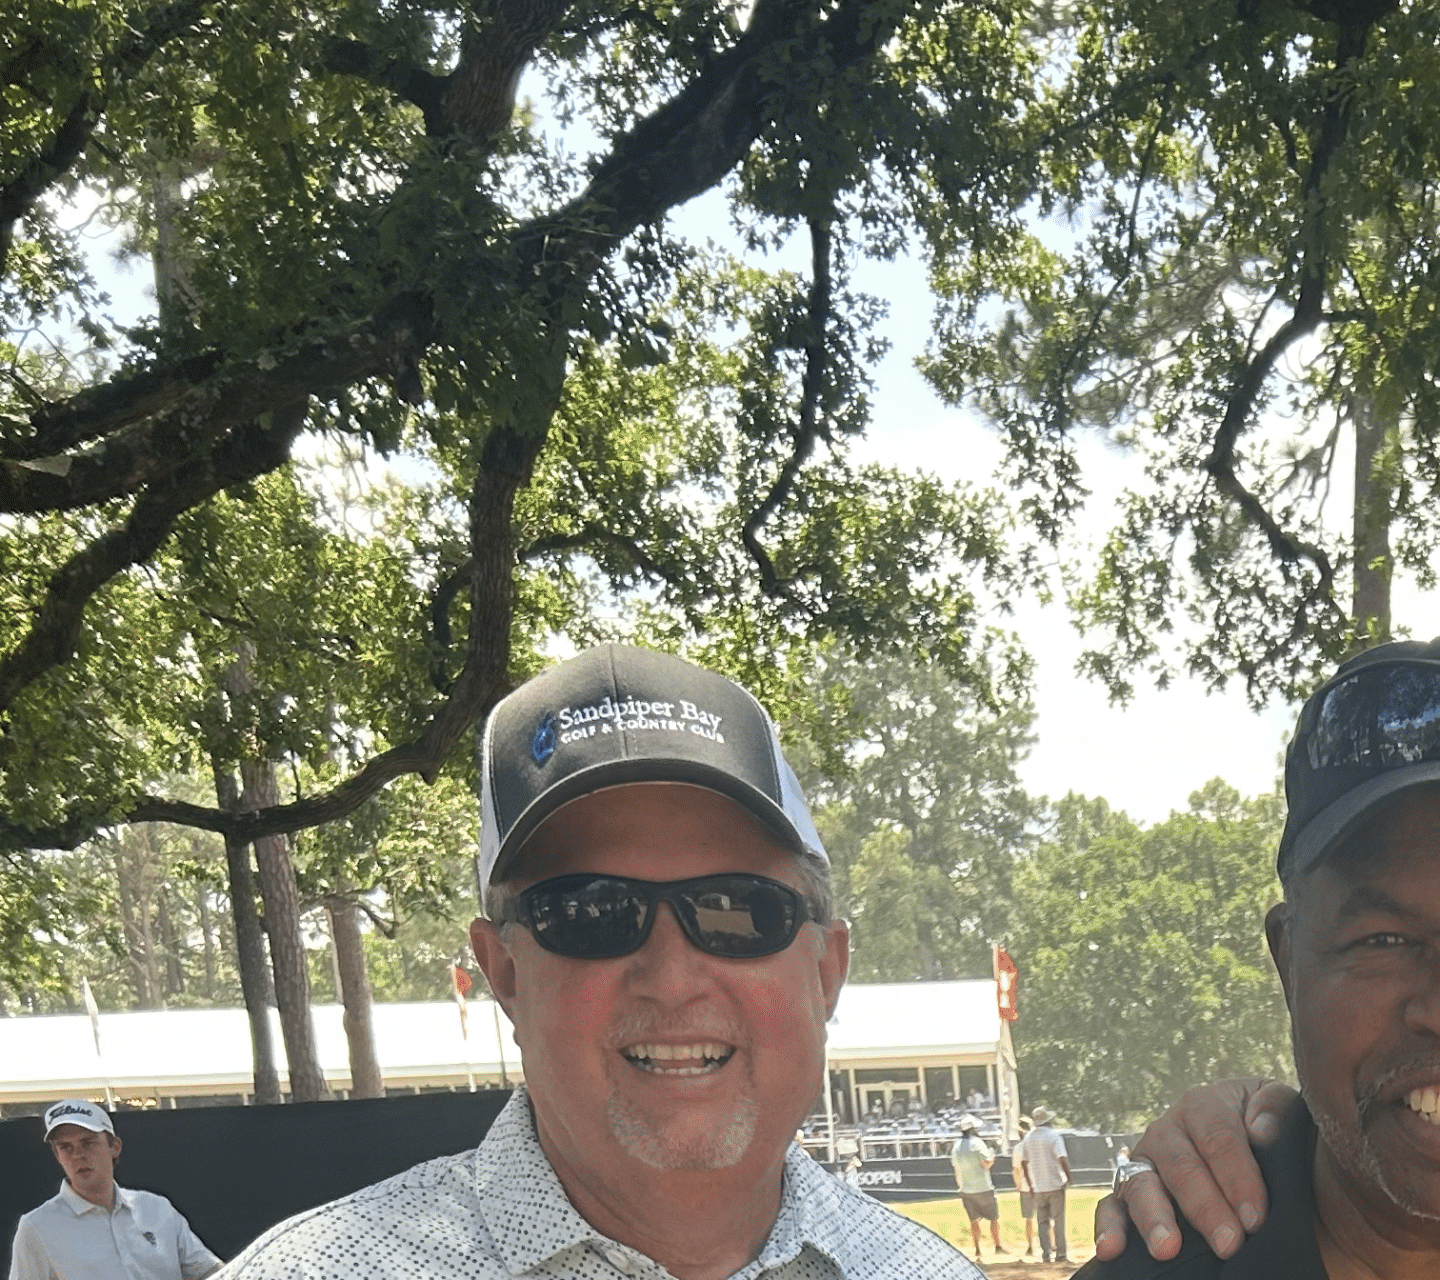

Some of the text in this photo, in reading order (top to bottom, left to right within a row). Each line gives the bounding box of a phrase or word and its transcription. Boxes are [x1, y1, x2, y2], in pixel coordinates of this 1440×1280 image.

[559, 695, 723, 732] Sandpiper Bay
[560, 725, 597, 745] GOLF
[601, 723, 613, 734] &
[616, 719, 686, 732] COUNTRY
